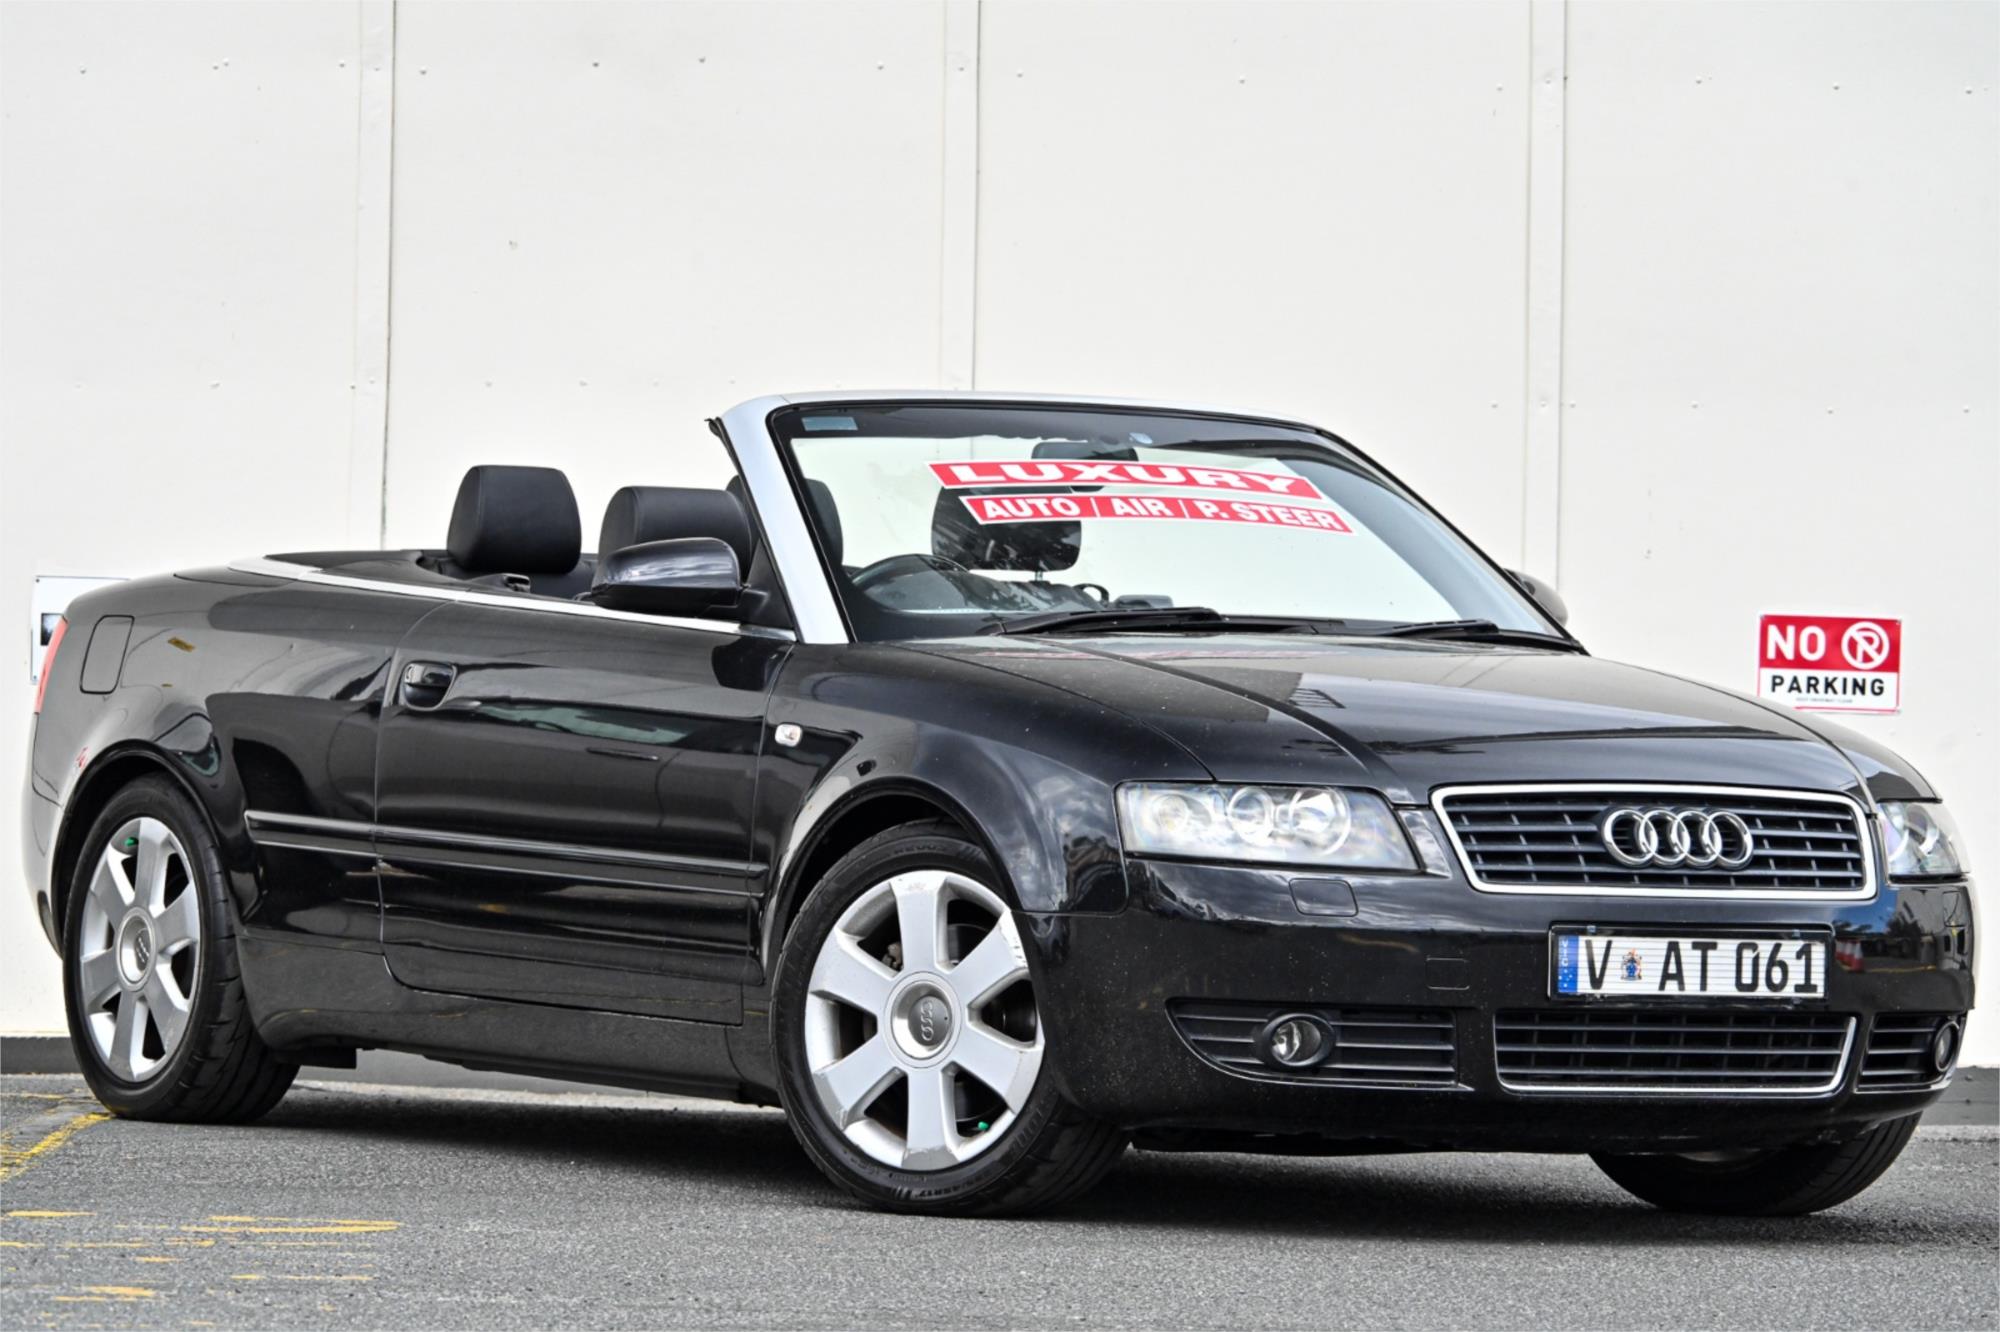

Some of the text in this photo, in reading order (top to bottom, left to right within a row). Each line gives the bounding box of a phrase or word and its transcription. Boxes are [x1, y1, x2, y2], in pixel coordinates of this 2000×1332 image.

[951, 463, 1301, 494] LUXURY
[985, 497, 1342, 530] AUTO AIR P. STEER
[1767, 624, 1826, 661] NO
[1771, 675, 1885, 696] PARKING
[1561, 939, 1569, 967] VIC
[1585, 939, 1612, 990] V
